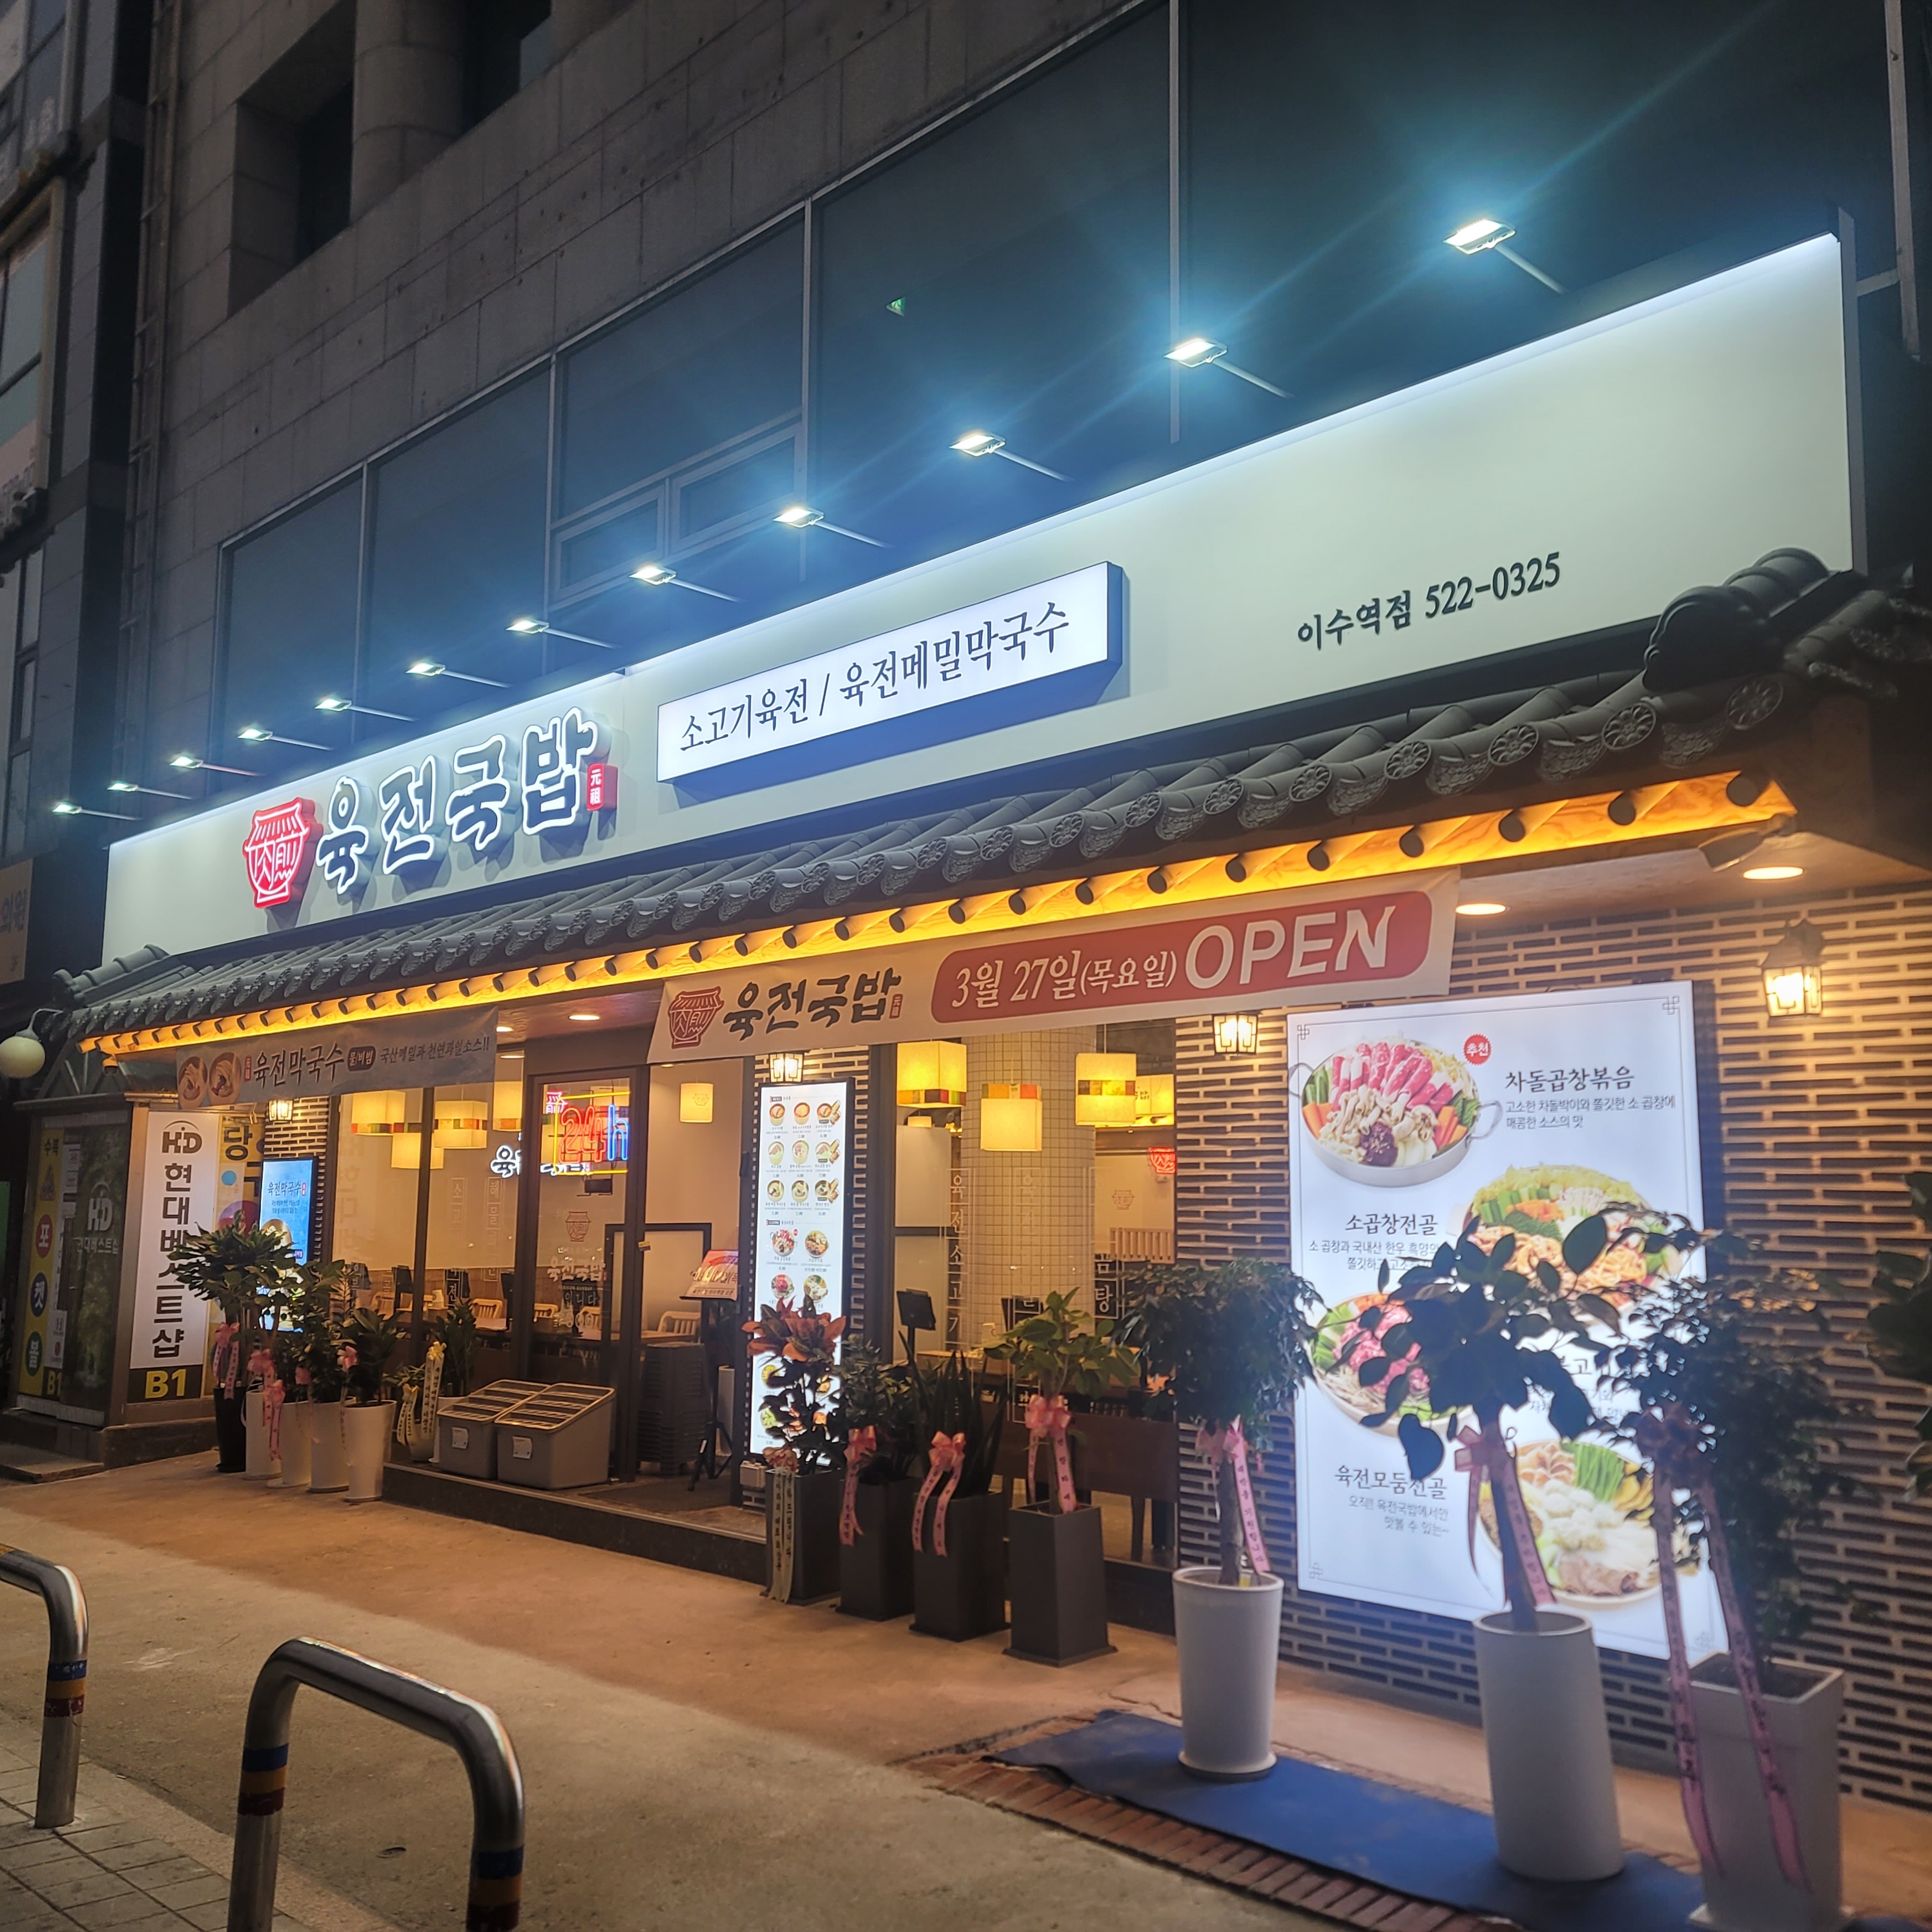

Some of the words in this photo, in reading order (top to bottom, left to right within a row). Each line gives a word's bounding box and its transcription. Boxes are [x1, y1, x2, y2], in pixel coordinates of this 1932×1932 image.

[1297, 590, 1411, 651] 이수역점
[1424, 551, 1561, 619] 522-0325
[680, 679, 808, 752] 소고기육전
[839, 601, 1069, 707] 육전메밀막국수
[316, 706, 599, 894] 육전국밥
[952, 960, 1003, 1009] 3월
[1011, 949, 1178, 1002] 27일(목요일)
[1186, 905, 1397, 990] OPEN
[723, 967, 902, 1042] 육전국밥
[1466, 1042, 1489, 1057] 추천
[253, 1041, 345, 1089] 육전막국수
[380, 1044, 426, 1065] 국산메밀과
[1505, 1065, 1634, 1094] 차돌곱창볶음
[1506, 1100, 1536, 1113] 고소한
[1538, 1098, 1590, 1111] 차돌박이와
[1592, 1097, 1625, 1111] 쫄깃한
[1627, 1098, 1639, 1109] 소
[1642, 1095, 1676, 1109] 곱창에
[1506, 1116, 1536, 1129] 매콤한
[1539, 1116, 1570, 1129] 소스의
[1573, 1115, 1584, 1128] 맛
[267, 1181, 302, 1197] 육전막국수
[1345, 1213, 1439, 1236] 소곱창전골
[1308, 1240, 1319, 1251] 소
[1321, 1240, 1350, 1253] 곱창과
[1352, 1240, 1382, 1255] 국내산
[1385, 1242, 1405, 1255] 한우
[145, 1368, 187, 1400] B1
